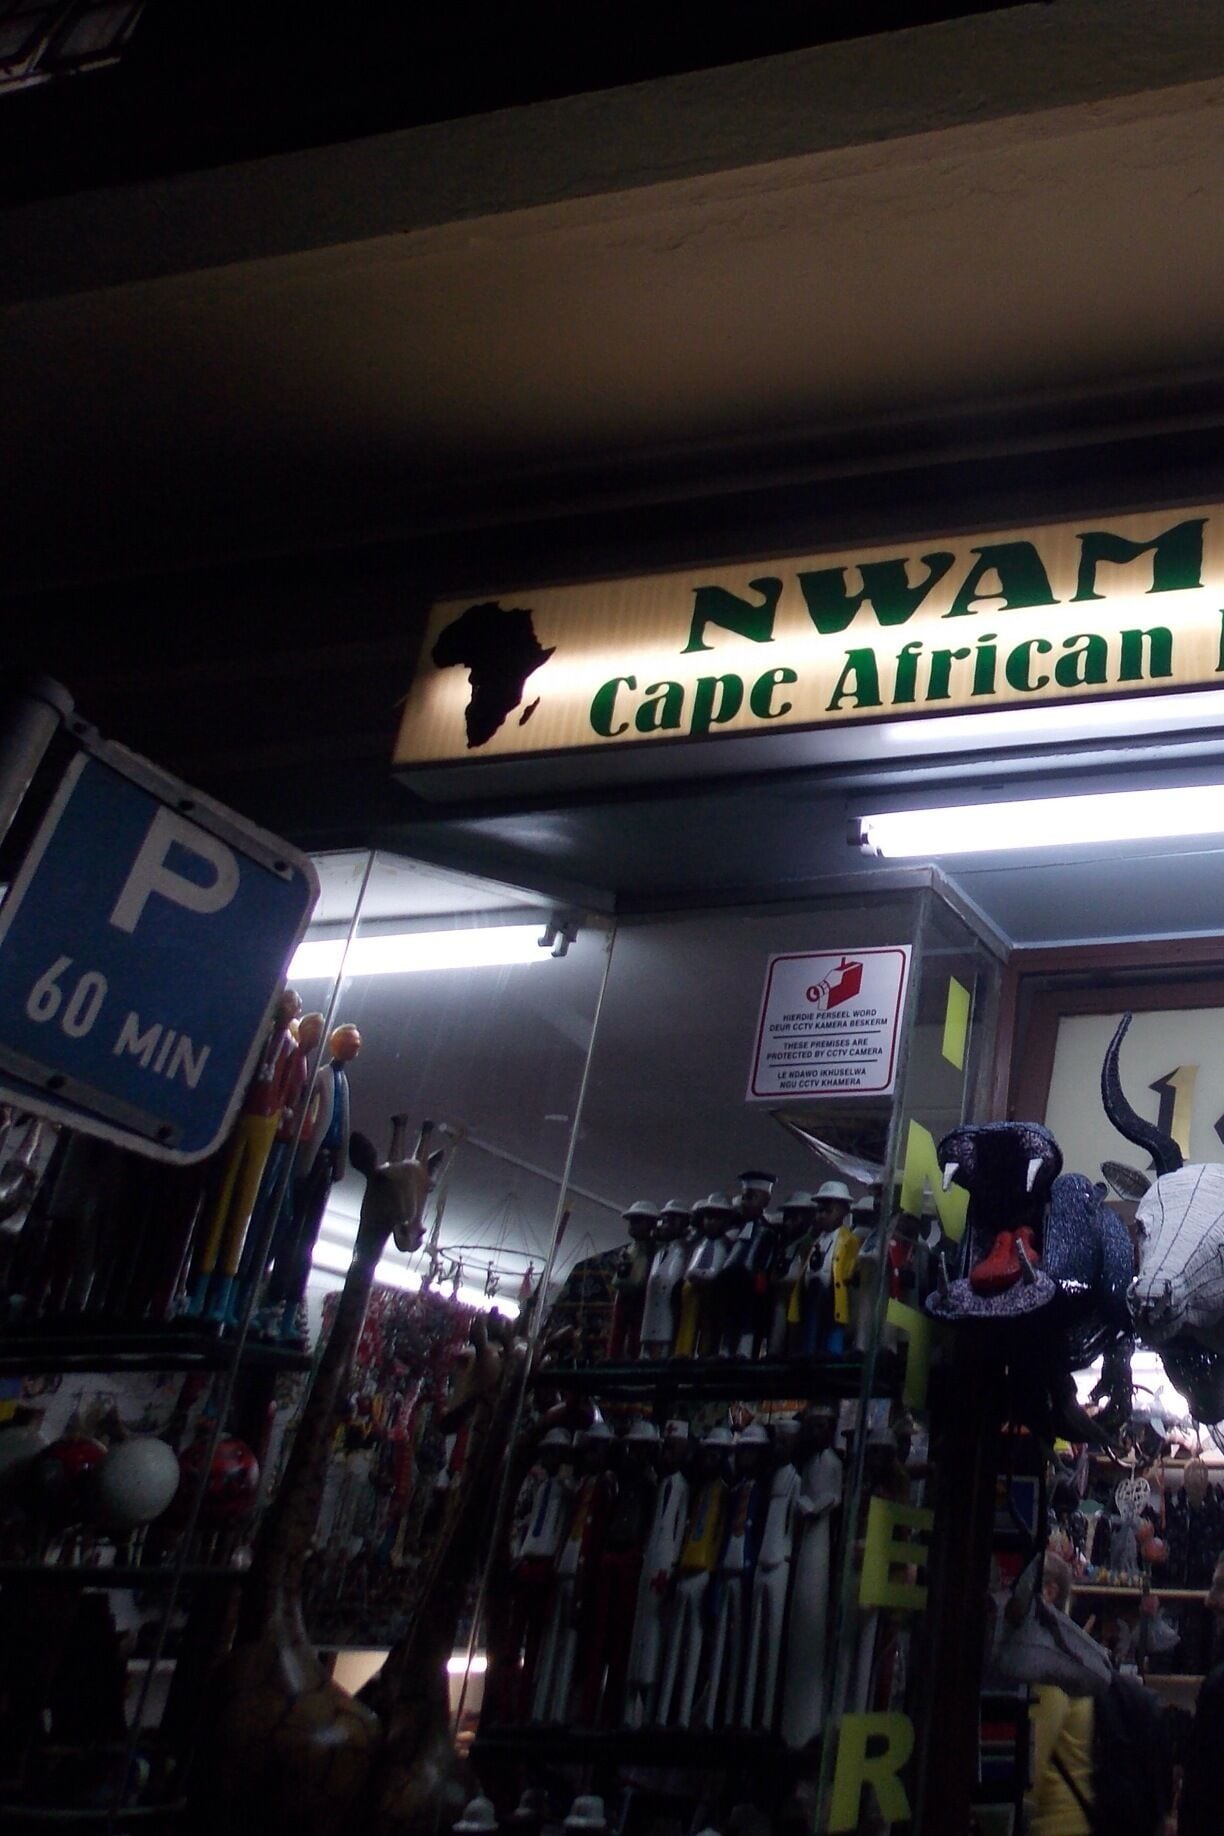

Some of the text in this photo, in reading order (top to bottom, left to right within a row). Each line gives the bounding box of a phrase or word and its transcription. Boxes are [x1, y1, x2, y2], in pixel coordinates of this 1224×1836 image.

[590, 667, 798, 738] Cape
[825, 626, 1173, 712] African
[110, 805, 240, 934] P
[26, 955, 211, 1089] 60 MIN
[783, 1009, 877, 1022] HIERDIE PERSEEL WORD
[769, 1018, 888, 1032] DEUR CCTV KAMERA BESKERM
[783, 1038, 868, 1050] THESE PREMISES ARE
[766, 1047, 883, 1061] PROTECTED BY CCTV CAMERA
[777, 1067, 867, 1080] LE NDAWO IKHUSELWA
[779, 1077, 861, 1089] NGU CCTV KHAMERA
